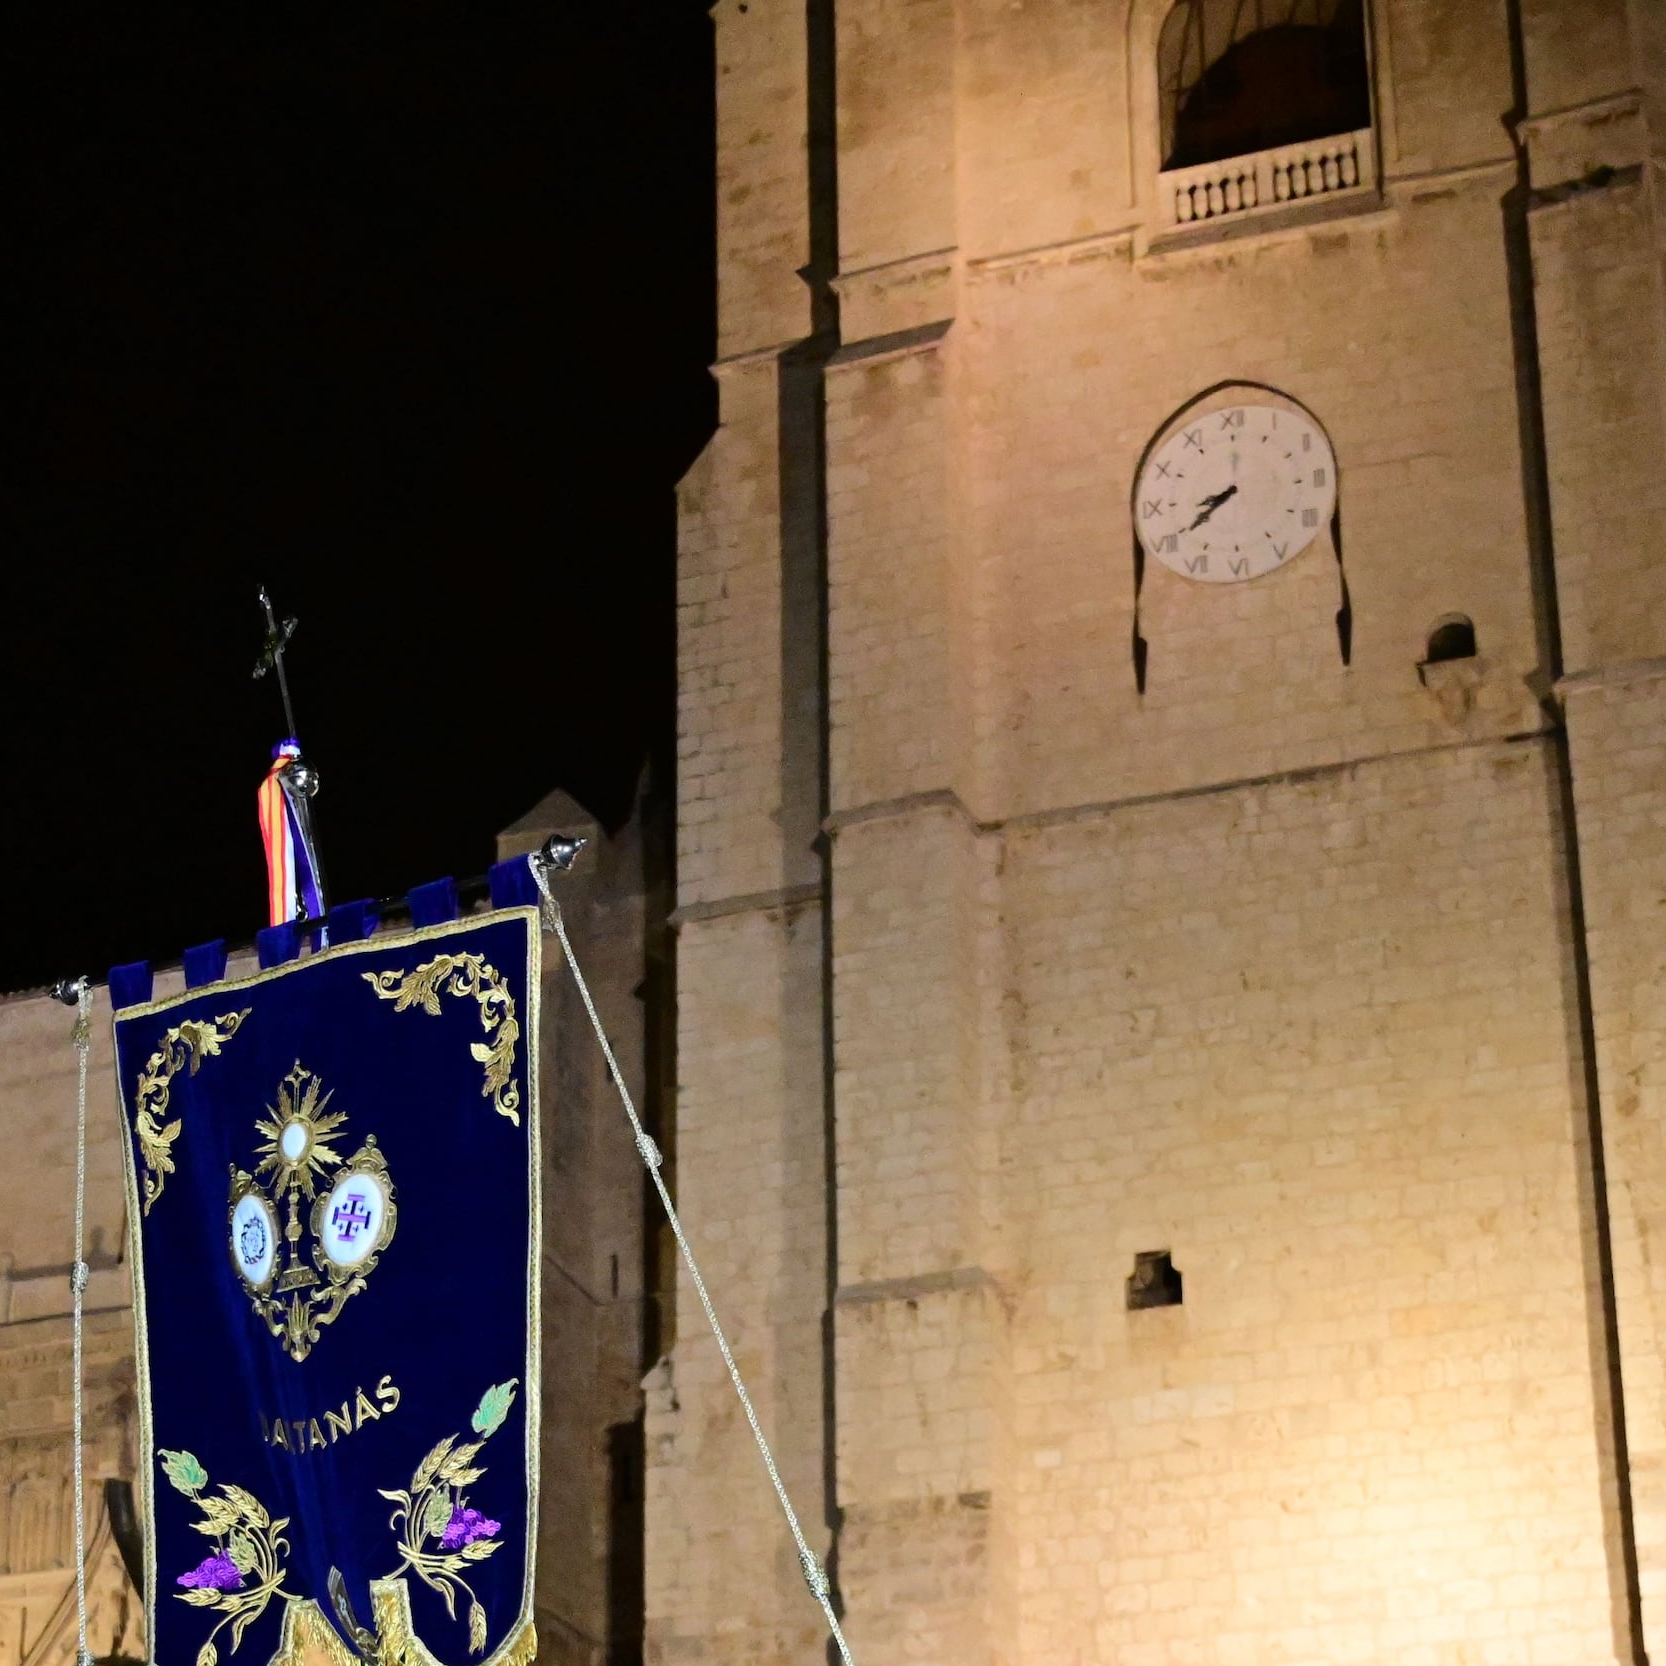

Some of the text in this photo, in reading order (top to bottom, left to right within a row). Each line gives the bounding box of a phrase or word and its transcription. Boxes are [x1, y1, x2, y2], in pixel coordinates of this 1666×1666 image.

[1221, 409, 1245, 430] XII
[1183, 429, 1203, 448] XI
[1302, 433, 1311, 452] II
[1157, 460, 1171, 480] X
[1143, 498, 1163, 519] IX
[1273, 543, 1288, 560] V
[1185, 555, 1208, 573] VII
[1228, 558, 1250, 576] VI
